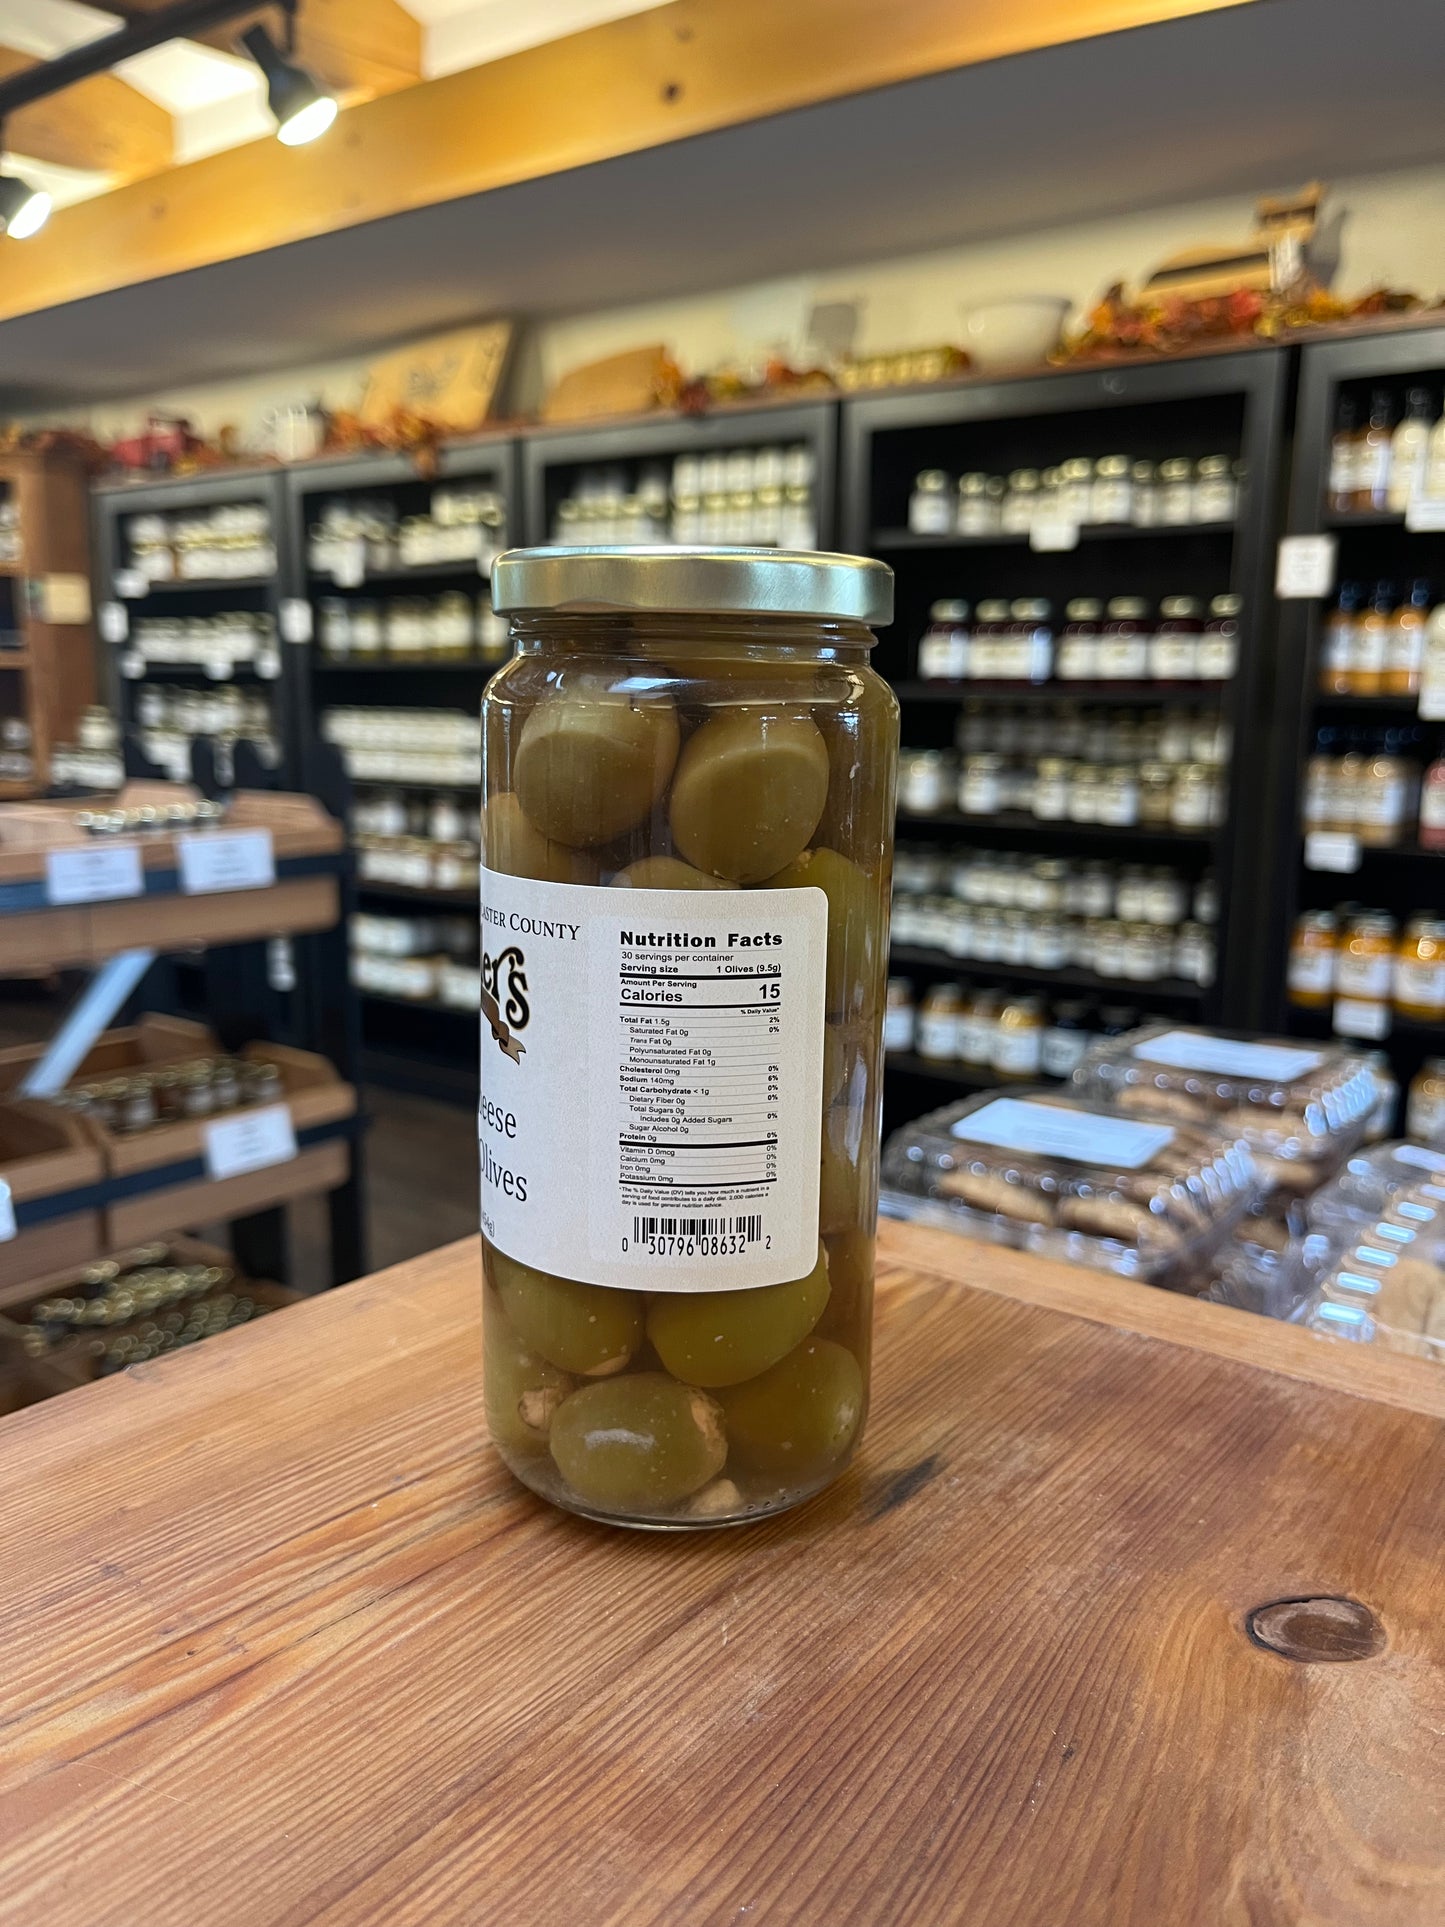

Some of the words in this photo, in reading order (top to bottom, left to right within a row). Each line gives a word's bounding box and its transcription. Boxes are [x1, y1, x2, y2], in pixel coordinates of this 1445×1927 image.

[482, 905, 506, 928] ASTER
[510, 913, 581, 941] COUNTY
[621, 931, 716, 947] Nutrition
[728, 932, 782, 947] Facts
[635, 953, 672, 962] servings
[621, 964, 656, 973] Serving
[660, 965, 678, 973] size
[757, 964, 781, 973] (9.5g)
[483, 946, 531, 1030] er's
[759, 984, 780, 998] 15
[621, 989, 682, 1001] Calories
[654, 1018, 670, 1026] 1.5g
[630, 1047, 686, 1055] Polyunsaturated
[630, 1056, 691, 1065] Monounsaturated
[620, 1066, 662, 1074] Cholesterol
[620, 1075, 648, 1083] Sodium
[651, 1077, 674, 1085] 140mg
[620, 1085, 638, 1093] Total
[640, 1087, 691, 1095] Carbohydrate
[630, 1096, 654, 1104] Dietary
[649, 1106, 673, 1114] Sugars
[479, 1094, 517, 1139] eese
[629, 1124, 650, 1132] Sugar
[620, 1146, 645, 1154] Vitamin
[620, 1155, 648, 1163] Calcium
[635, 1165, 651, 1173] 0mg
[620, 1173, 656, 1181] Potassium
[622, 1238, 628, 1251] 0
[649, 1236, 694, 1256] 30796
[701, 1235, 745, 1255] 08632
[766, 1236, 771, 1249] 2
